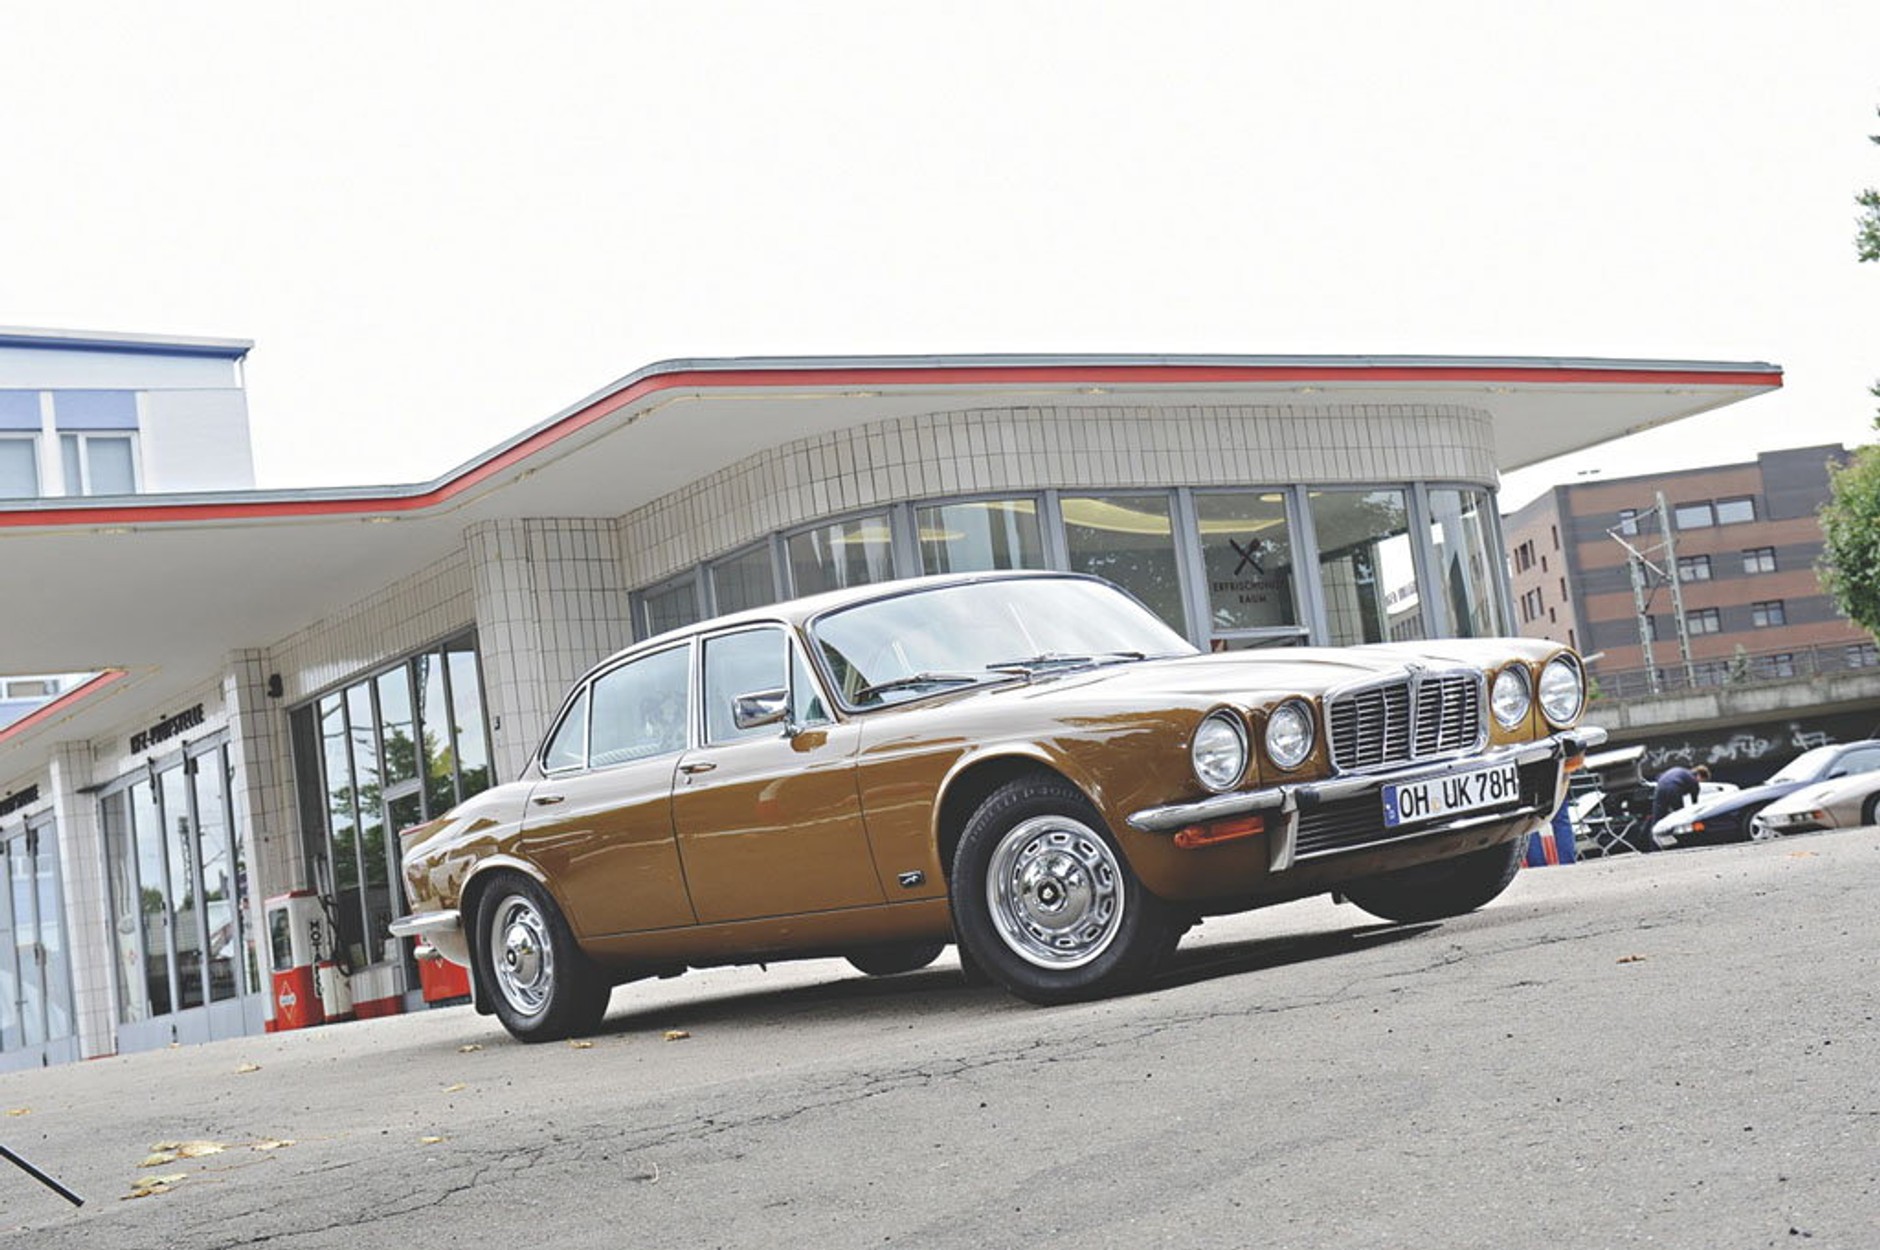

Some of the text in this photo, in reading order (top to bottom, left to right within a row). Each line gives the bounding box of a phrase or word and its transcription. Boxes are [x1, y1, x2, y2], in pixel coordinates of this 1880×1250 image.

[1399, 767, 1517, 818] OH UK 78H
